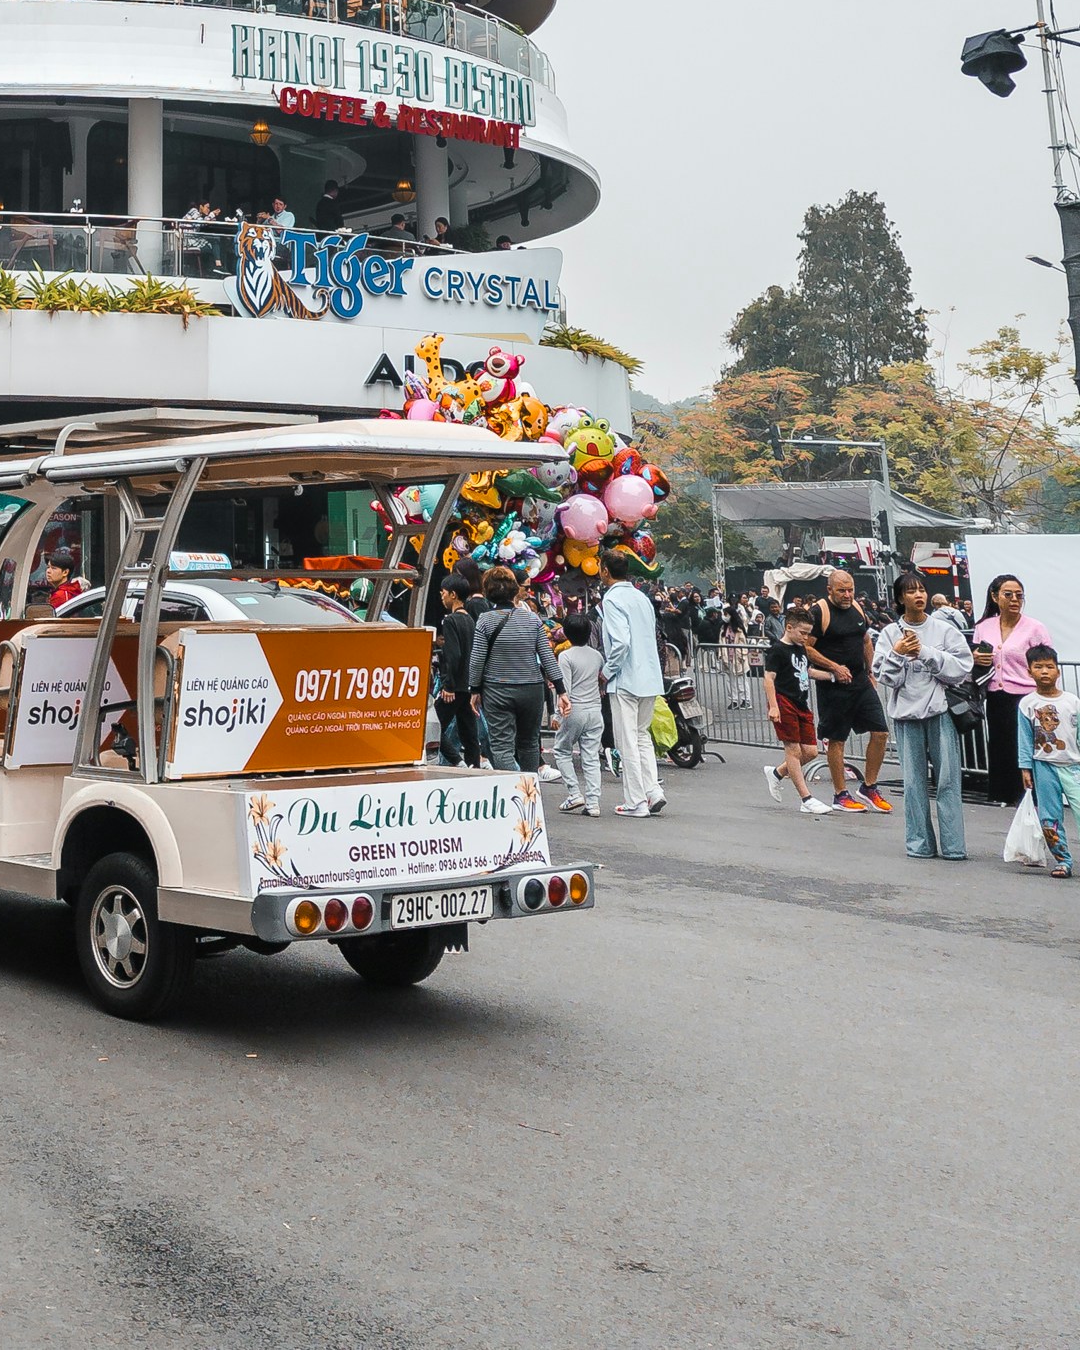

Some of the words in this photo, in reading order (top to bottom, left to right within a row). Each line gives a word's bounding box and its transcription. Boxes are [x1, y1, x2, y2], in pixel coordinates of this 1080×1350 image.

[232, 23, 346, 90] HANOI
[357, 39, 435, 102] 1930
[445, 56, 536, 128] BISTRO
[279, 87, 368, 127] COFFEE
[373, 100, 392, 129] &
[398, 104, 523, 149] RESTAURANT
[281, 231, 415, 320] Tiger
[422, 266, 560, 310] CRYSTAL
[31, 680, 49, 692] LIÊN
[51, 680, 62, 694] HỆ
[64, 679, 87, 692] QUẢN
[186, 678, 205, 691] LIÊN
[207, 677, 219, 693] HỆ
[220, 676, 250, 691] QUẢNG
[251, 676, 269, 689] CÁO
[294, 668, 342, 703] 0971
[346, 667, 369, 700] 79
[370, 666, 395, 699] 89
[397, 665, 420, 698] 79
[183, 697, 267, 733] shojiki
[285, 723, 309, 736] QUẢNG
[309, 723, 324, 734] CÁO
[361, 723, 383, 731] TRUNG
[287, 711, 312, 723] QUẢNG
[312, 711, 326, 721] CÁO
[364, 710, 378, 719] KHU
[288, 797, 341, 836] Du
[348, 791, 418, 838] Lịch
[426, 784, 510, 825] Xanh
[348, 842, 396, 863] GREEN
[400, 836, 463, 858] TOURISM
[287, 866, 397, 890] dongxuantours@gmail.com
[407, 861, 438, 875] Hotline:
[439, 858, 458, 872] 0936
[459, 857, 473, 869] 624
[474, 855, 488, 867] 566
